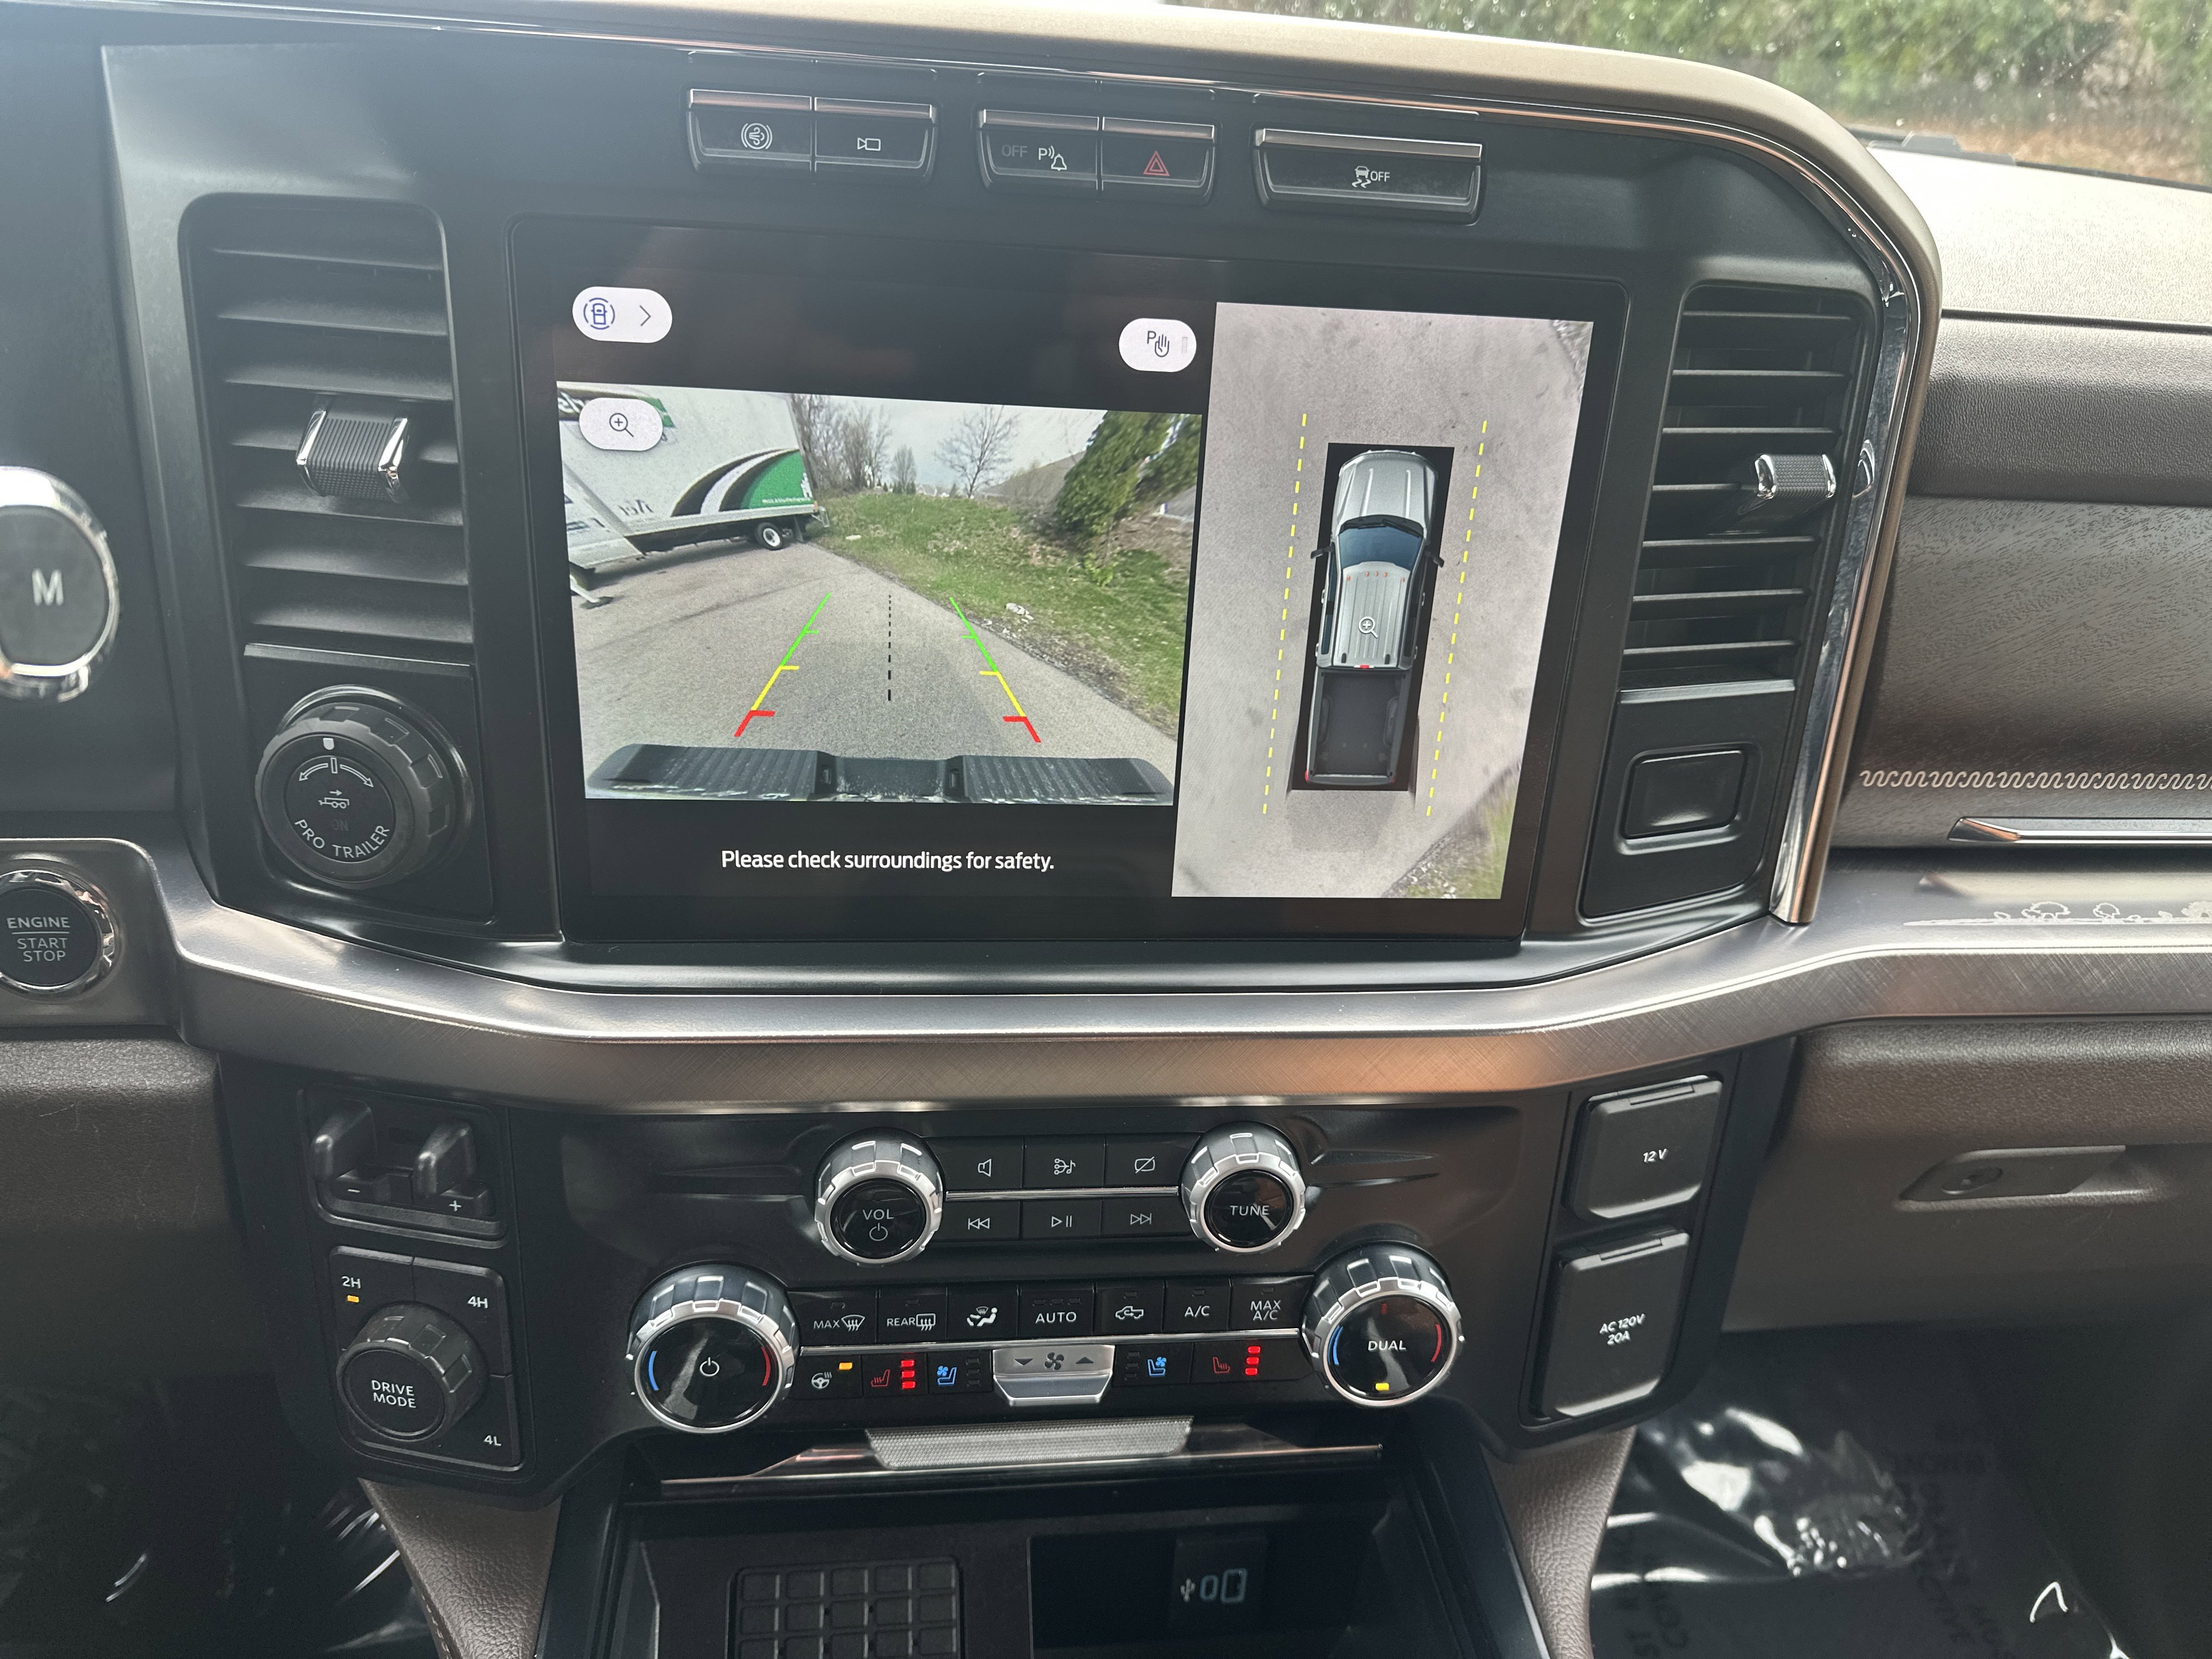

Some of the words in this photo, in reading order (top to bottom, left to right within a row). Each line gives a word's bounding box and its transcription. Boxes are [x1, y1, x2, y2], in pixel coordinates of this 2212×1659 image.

[1002, 145, 1027, 157] OFF
[1370, 171, 1390, 184] OFF
[1147, 330, 1156, 345] P
[32, 569, 63, 605] M
[295, 820, 325, 848] PRO
[332, 825, 390, 859] TRAILER
[722, 850, 784, 867] Please
[788, 850, 840, 868] check
[845, 851, 962, 872] surroundings
[966, 851, 991, 868] for
[995, 852, 1054, 872] safety.
[7, 917, 70, 928] ENGINE
[18, 938, 67, 949] START
[24, 951, 65, 962] STOP
[863, 1209, 894, 1220] VOL
[1230, 1204, 1270, 1216] TUNE
[342, 1276, 360, 1288] 2H
[468, 1296, 488, 1308] 4H
[1250, 1300, 1281, 1311] MAX
[1185, 1306, 1209, 1317] A/C
[1252, 1310, 1278, 1321] A/C
[887, 1318, 915, 1326] REAR
[1036, 1312, 1076, 1323] AUTO
[814, 1320, 839, 1328] MAX
[1607, 1330, 1631, 1346] 20A
[1368, 1340, 1406, 1351] DUAL
[371, 1380, 414, 1396] DRIVE
[373, 1392, 416, 1409] MODE
[484, 1435, 501, 1446] 4L
